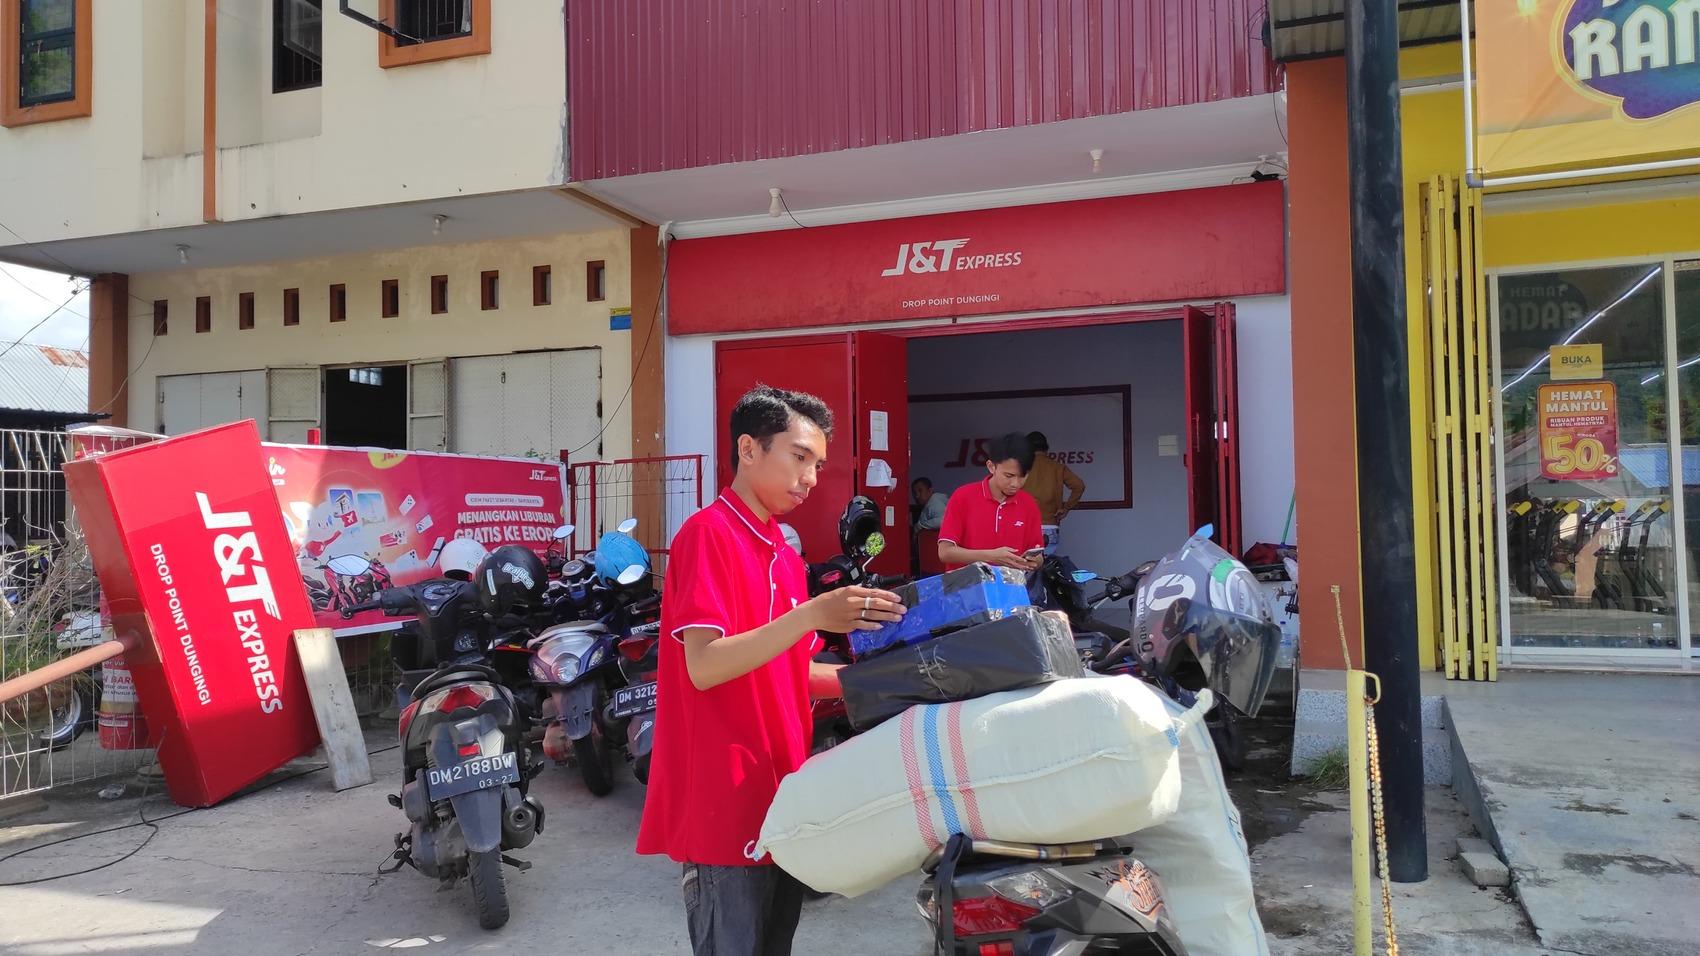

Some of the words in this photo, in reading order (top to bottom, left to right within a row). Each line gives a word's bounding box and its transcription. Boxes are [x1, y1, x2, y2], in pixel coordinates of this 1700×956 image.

[881, 238, 970, 277] J&T
[955, 252, 1022, 270] EXPRESS
[902, 300, 926, 308] DROP
[928, 298, 954, 306] POINT
[956, 294, 1000, 304] DUNGINGI
[1561, 356, 1592, 364] BUKA
[1551, 390, 1602, 400] HEMAT
[1546, 401, 1608, 412] MANTUL
[944, 438, 992, 468] J&
[1544, 434, 1617, 475] 50%
[457, 510, 519, 524] MENANGKAN
[519, 510, 556, 524] LIBURAN
[504, 525, 519, 541] KE
[521, 526, 561, 542] EROP
[195, 491, 282, 621] J&T
[150, 543, 173, 585] DROP
[165, 587, 189, 632] POINT
[180, 634, 211, 706] DUNGINGI
[232, 609, 283, 714] EXPRESS
[619, 691, 632, 703] DM
[635, 684, 657, 699] 3212
